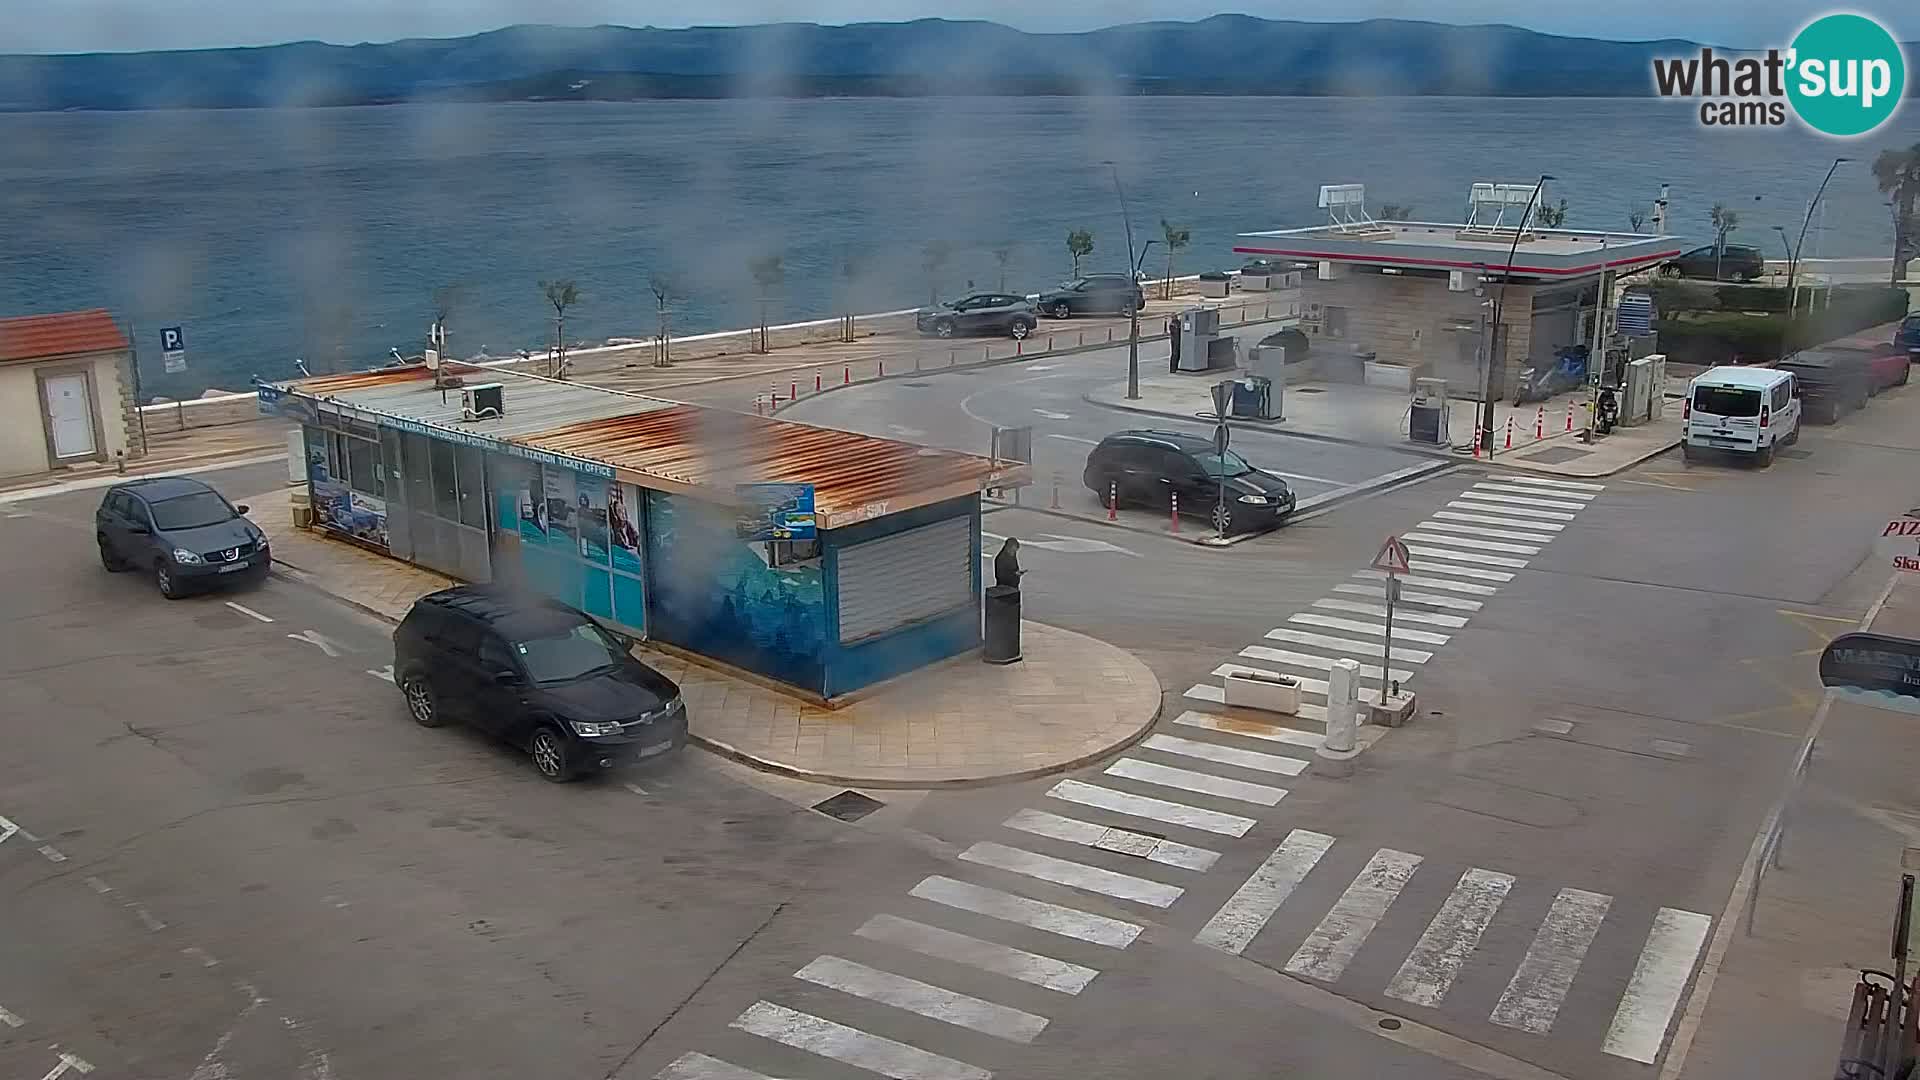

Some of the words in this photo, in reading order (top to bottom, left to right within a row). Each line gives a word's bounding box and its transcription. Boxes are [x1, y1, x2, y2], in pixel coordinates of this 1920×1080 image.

[166, 330, 178, 349] P
[525, 450, 556, 465] STATION
[558, 457, 583, 471] TICKET
[585, 463, 612, 476] OFFICE
